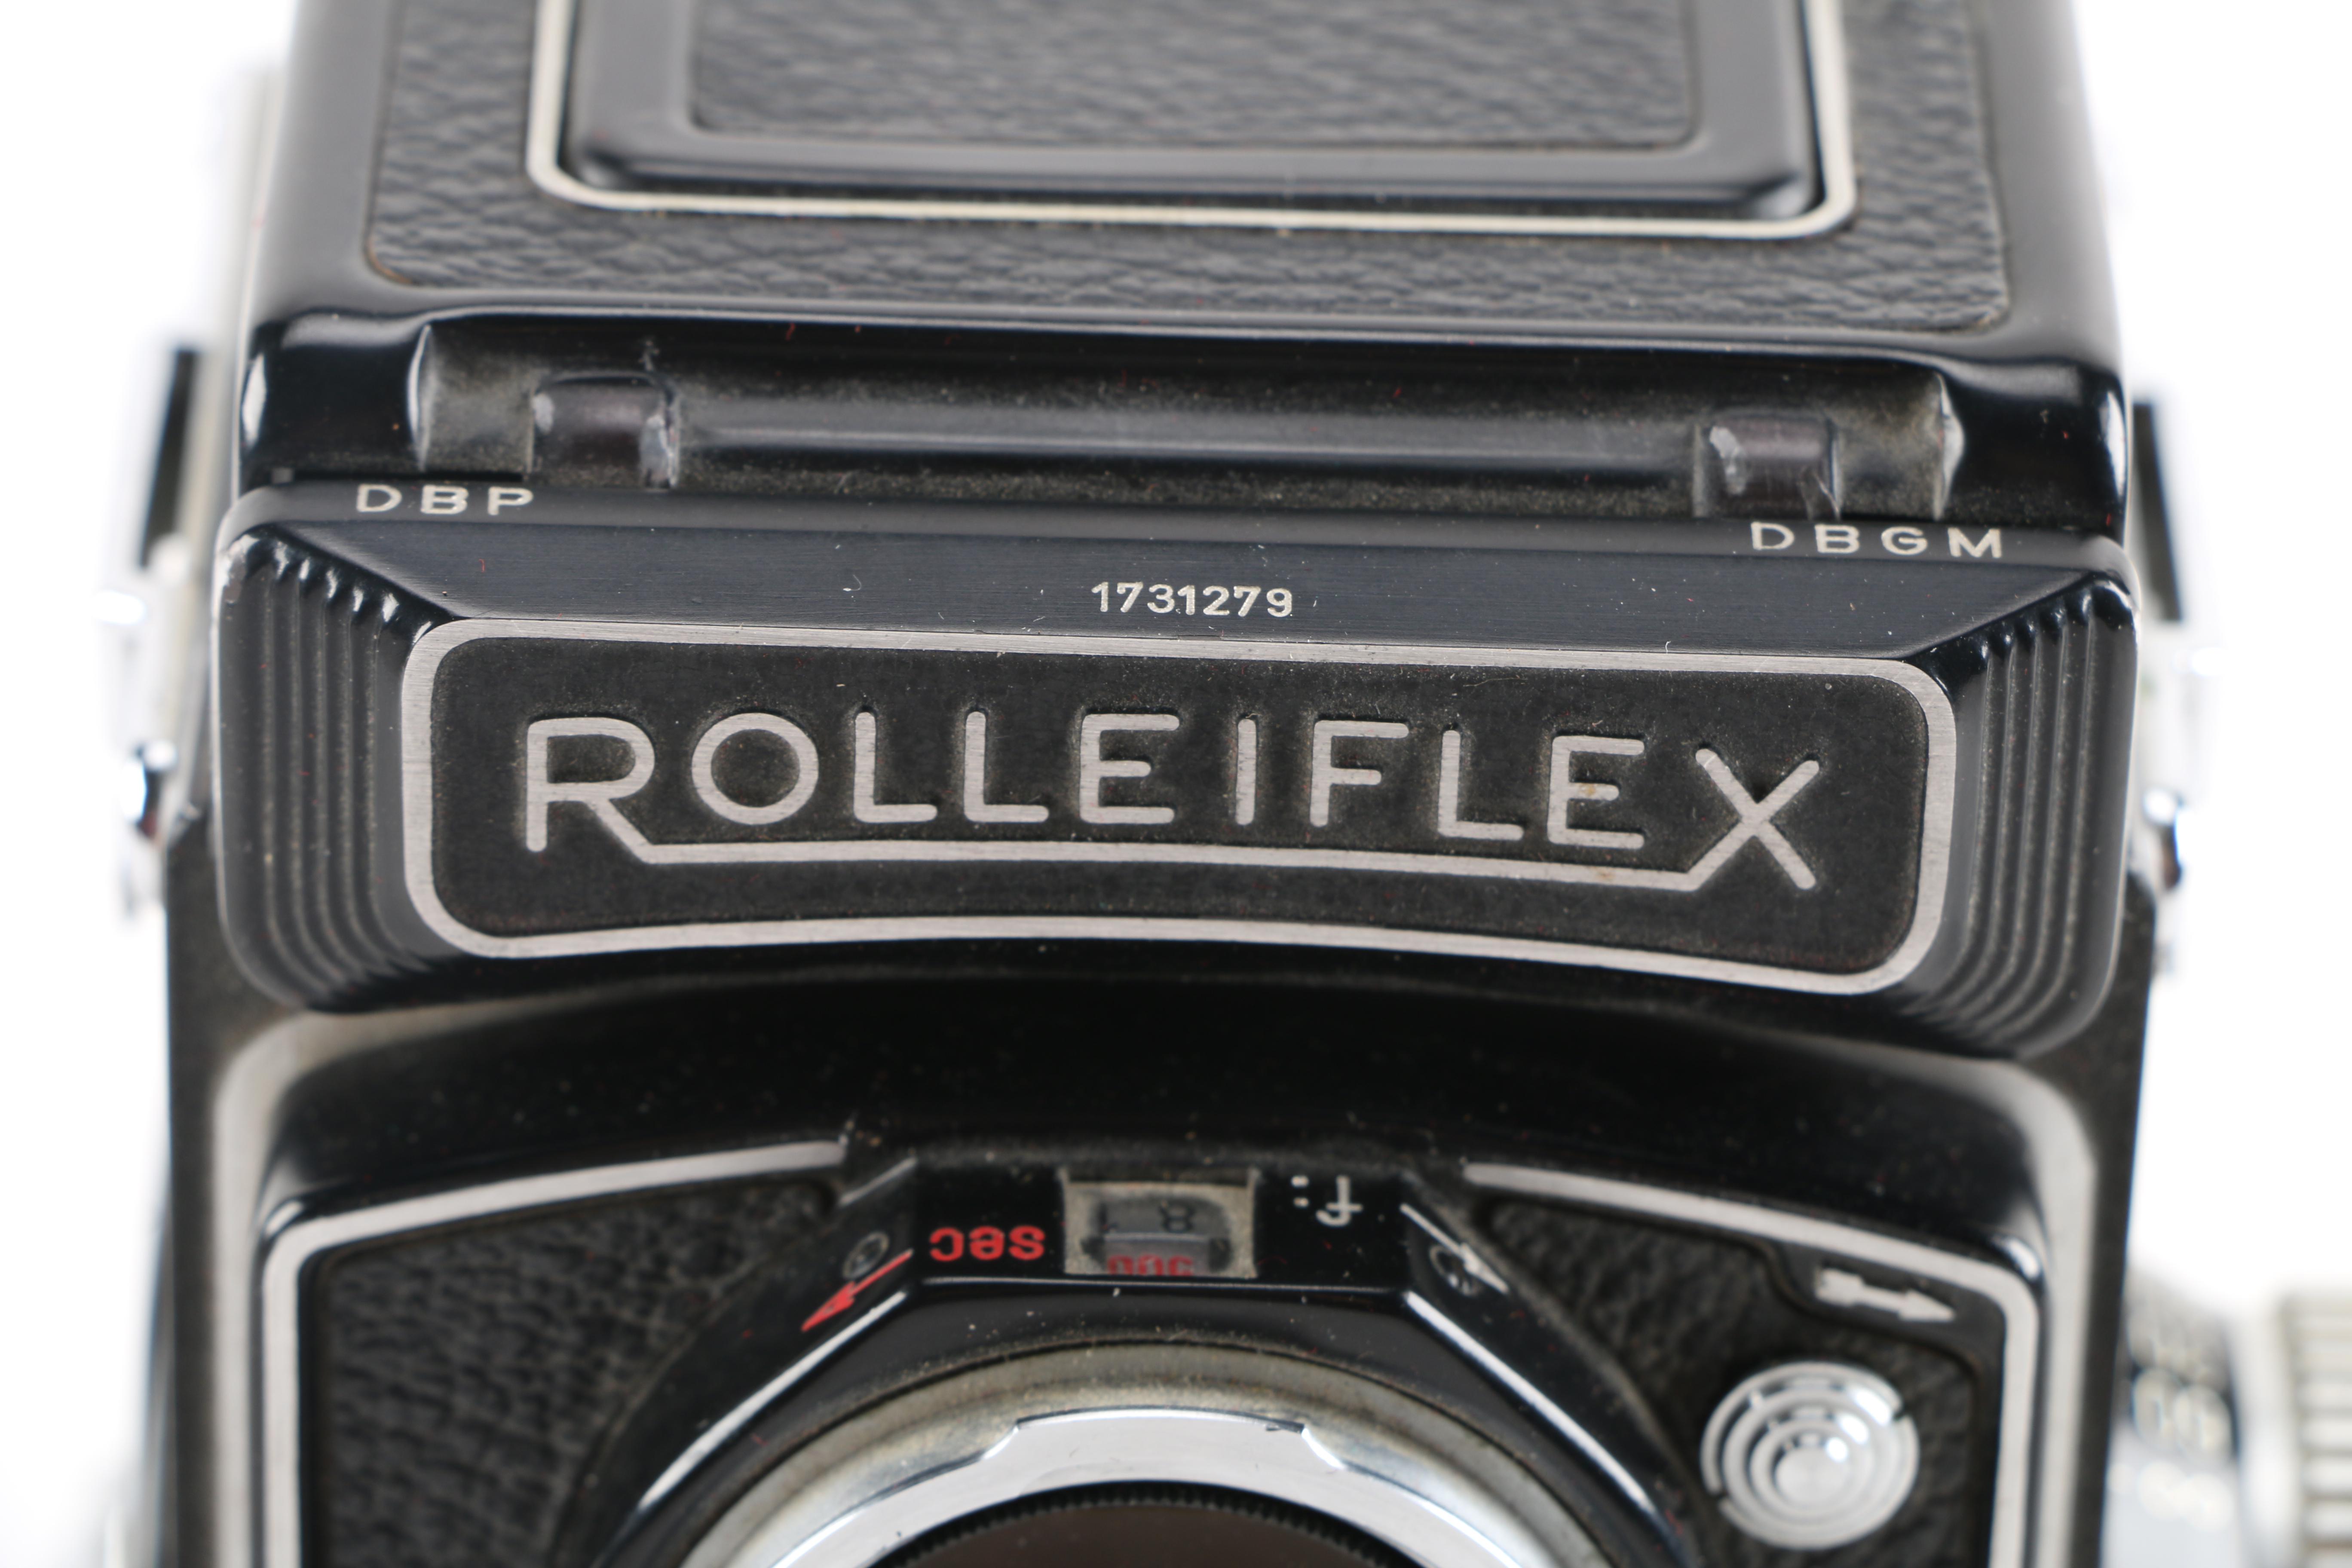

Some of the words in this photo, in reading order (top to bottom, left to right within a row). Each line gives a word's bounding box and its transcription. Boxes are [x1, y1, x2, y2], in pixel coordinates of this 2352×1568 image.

[356, 485, 533, 515] DBP
[1750, 521, 2002, 558] DBGM
[1091, 582, 1292, 617] 1731279
[520, 711, 1820, 893] ROLLEIFLEX
[1161, 1197, 1195, 1233] 8
[931, 1226, 1044, 1261] sec
